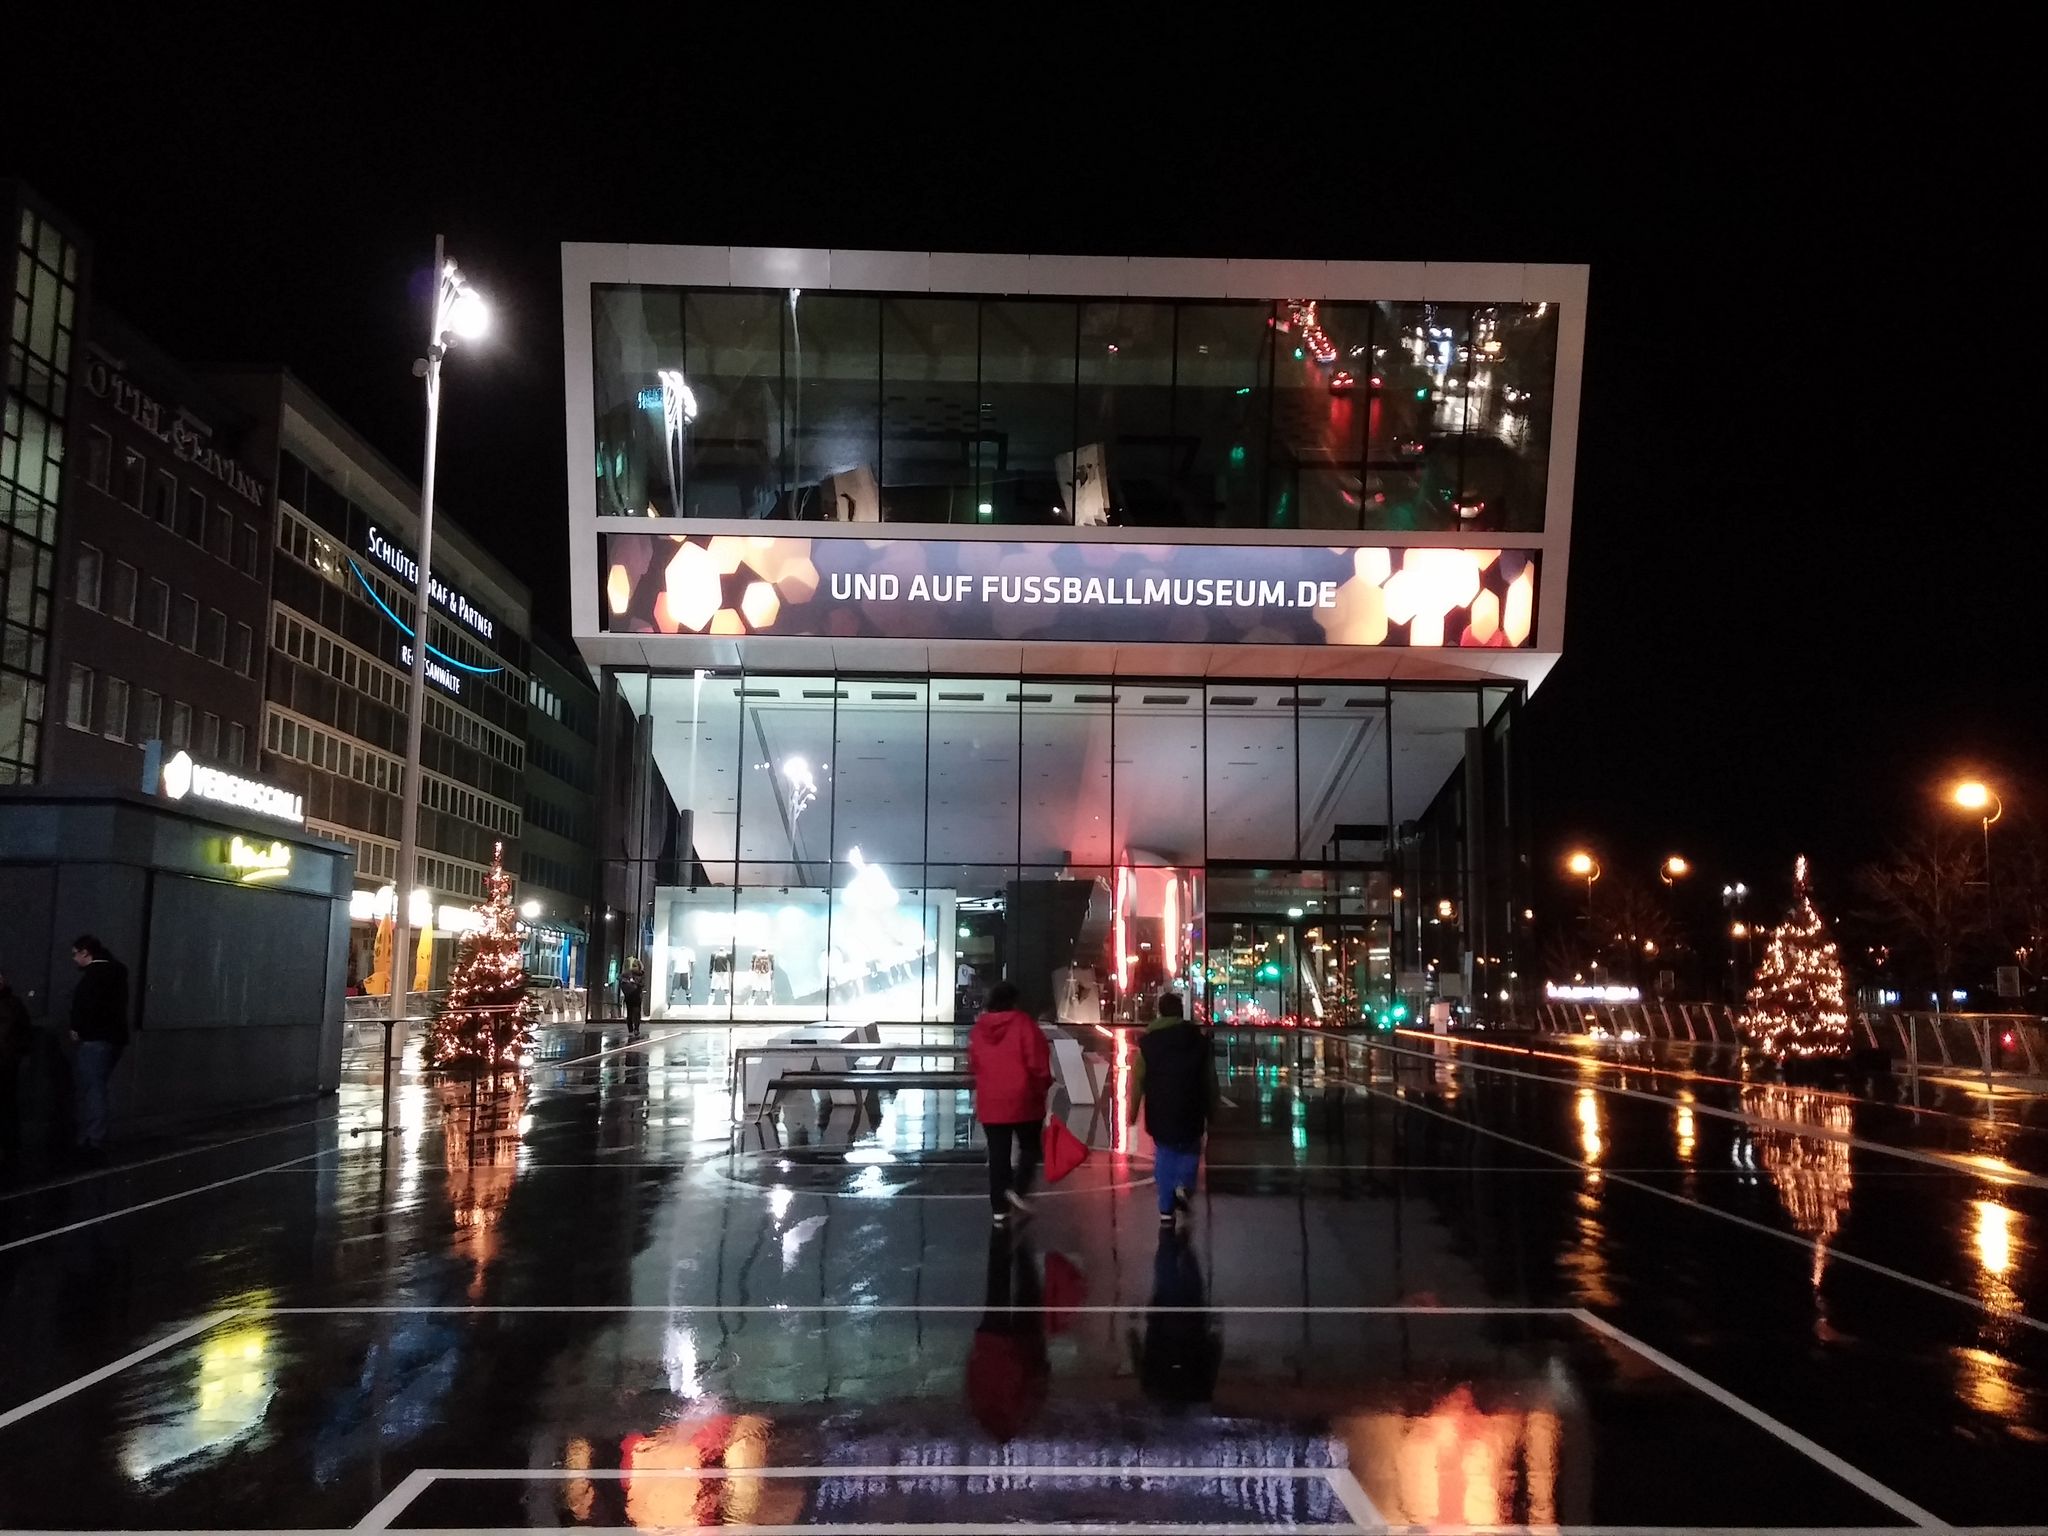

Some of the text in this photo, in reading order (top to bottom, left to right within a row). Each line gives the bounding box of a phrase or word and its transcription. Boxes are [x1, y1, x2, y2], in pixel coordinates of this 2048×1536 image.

[831, 573, 1338, 608] UND AUF FUSSBALLMUSEUM.DE
[449, 592, 457, 614] &
[458, 596, 493, 639] PARTNER
[401, 645, 460, 695] RESANWÄLTE
